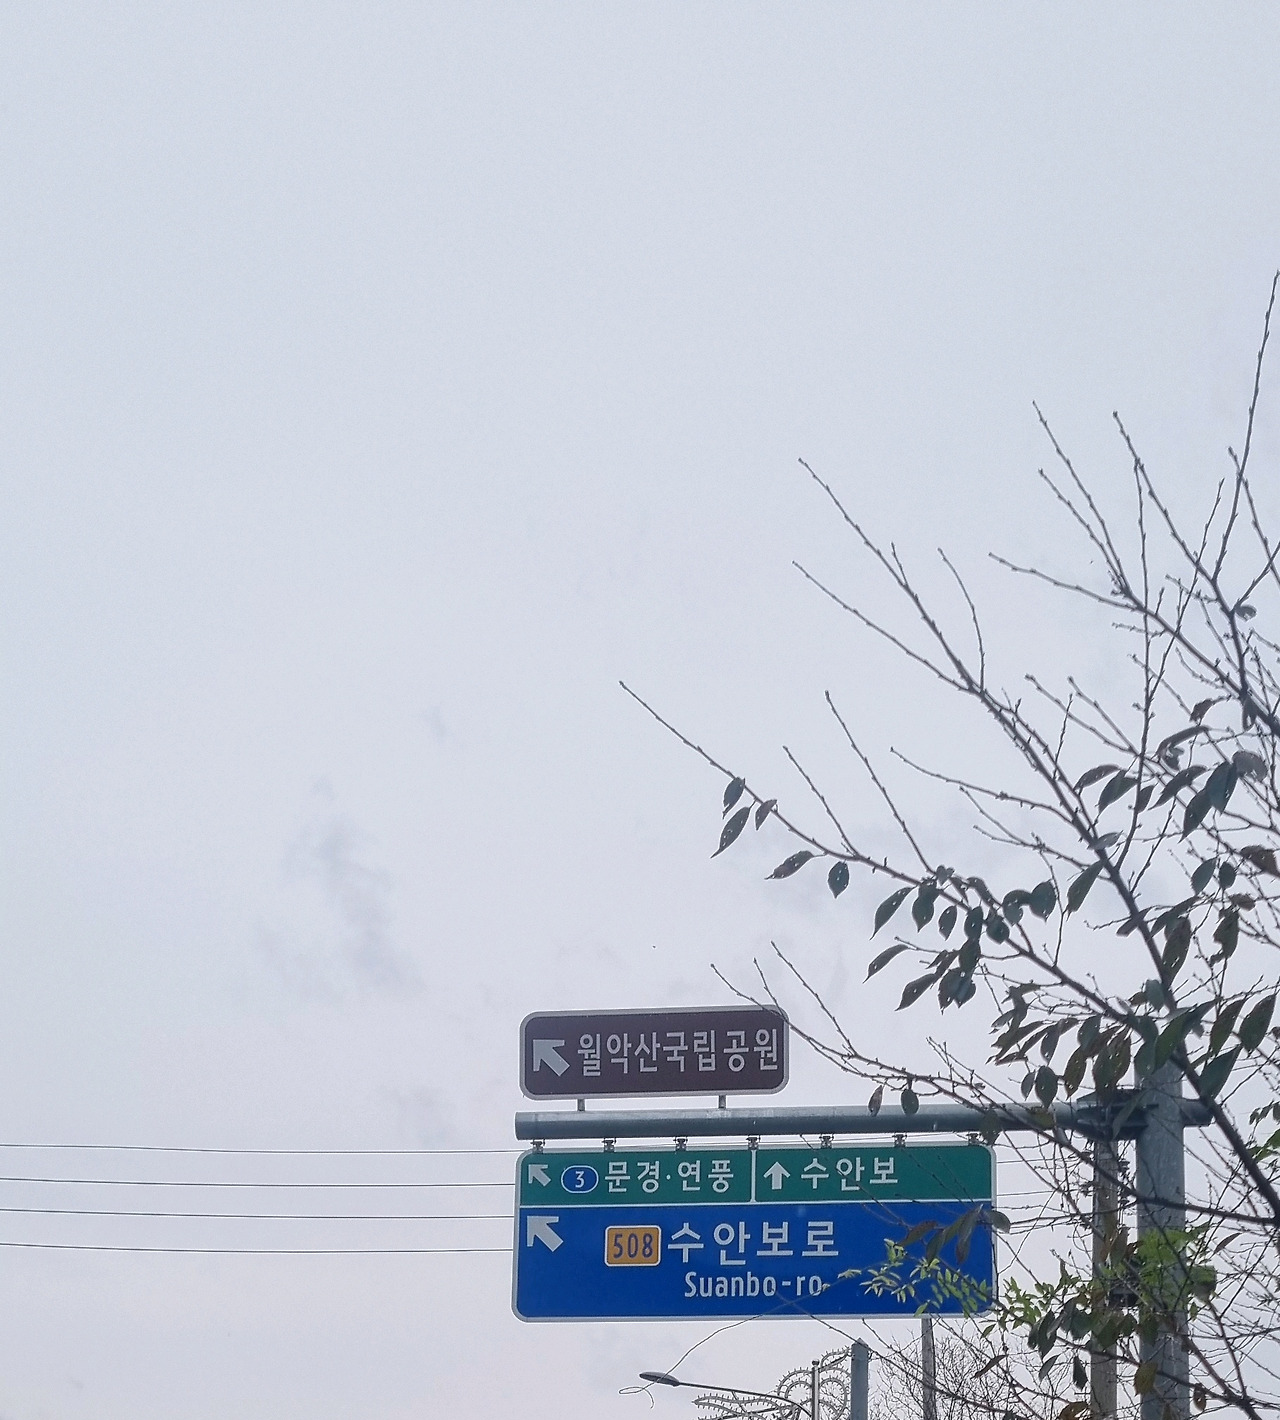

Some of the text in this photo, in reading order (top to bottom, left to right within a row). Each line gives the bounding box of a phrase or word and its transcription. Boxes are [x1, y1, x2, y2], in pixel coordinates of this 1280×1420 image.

[577, 1027, 779, 1078] 월악산국립공원
[574, 1171, 586, 1188] 3
[801, 1157, 898, 1192] 수안보
[612, 1232, 654, 1260] 508
[668, 1221, 839, 1266] 수안보로
[684, 1271, 823, 1298] Suanbo-ro
